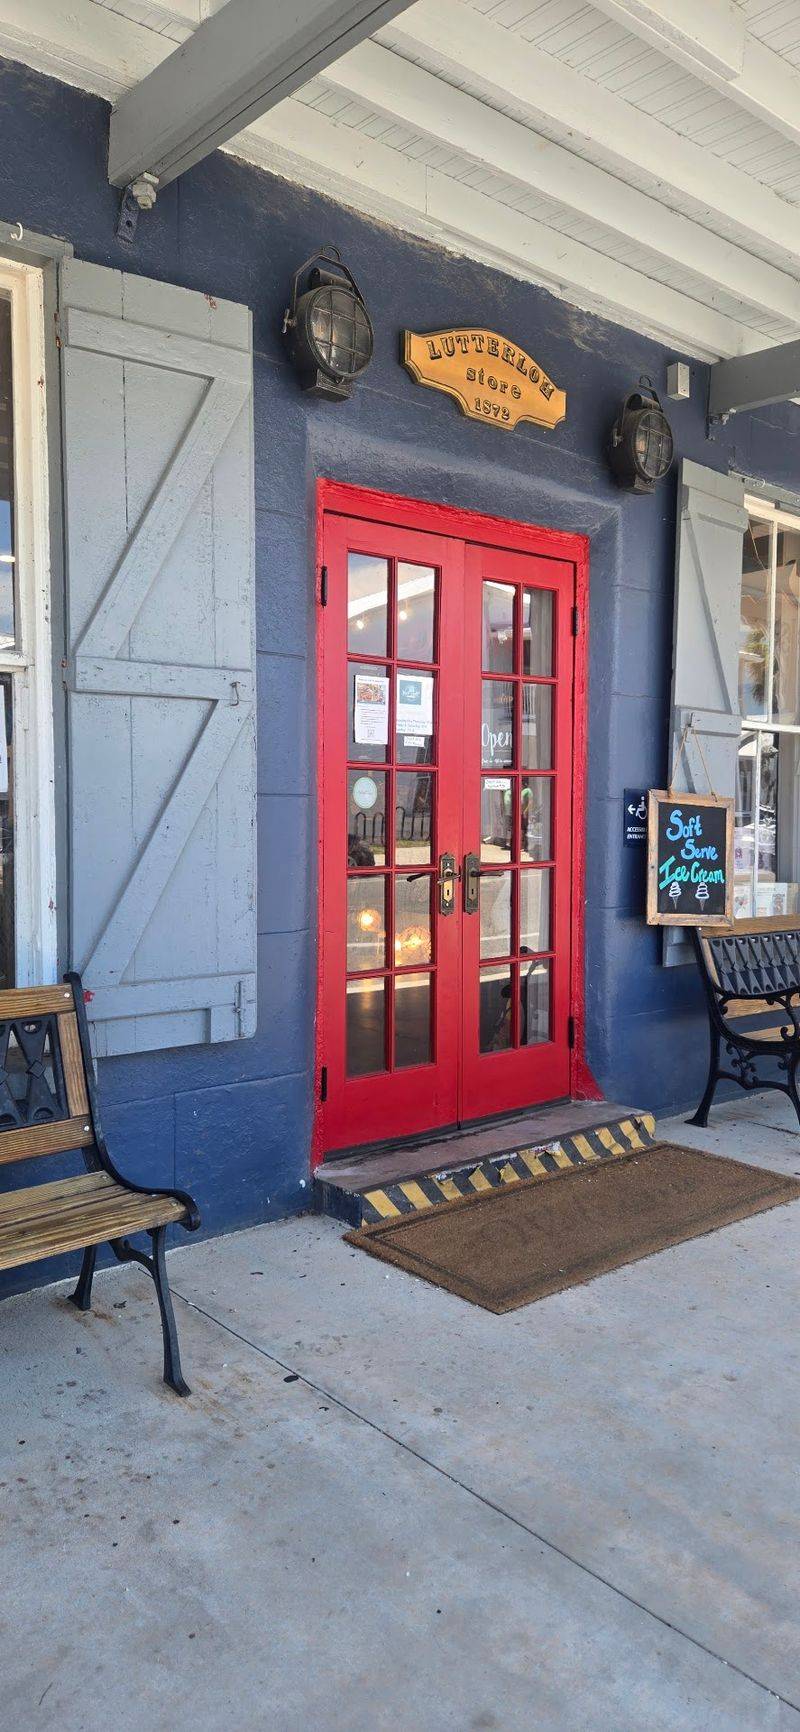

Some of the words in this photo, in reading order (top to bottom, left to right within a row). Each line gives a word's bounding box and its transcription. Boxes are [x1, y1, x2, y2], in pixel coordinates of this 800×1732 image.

[426, 334, 555, 401] LUTTERLOH
[466, 367, 522, 399] store
[474, 397, 511, 420] 1872
[482, 722, 513, 757] Open
[666, 809, 703, 841] Soft
[681, 839, 719, 860] Serve
[659, 855, 690, 890] Ice
[691, 861, 725, 884] Cream
